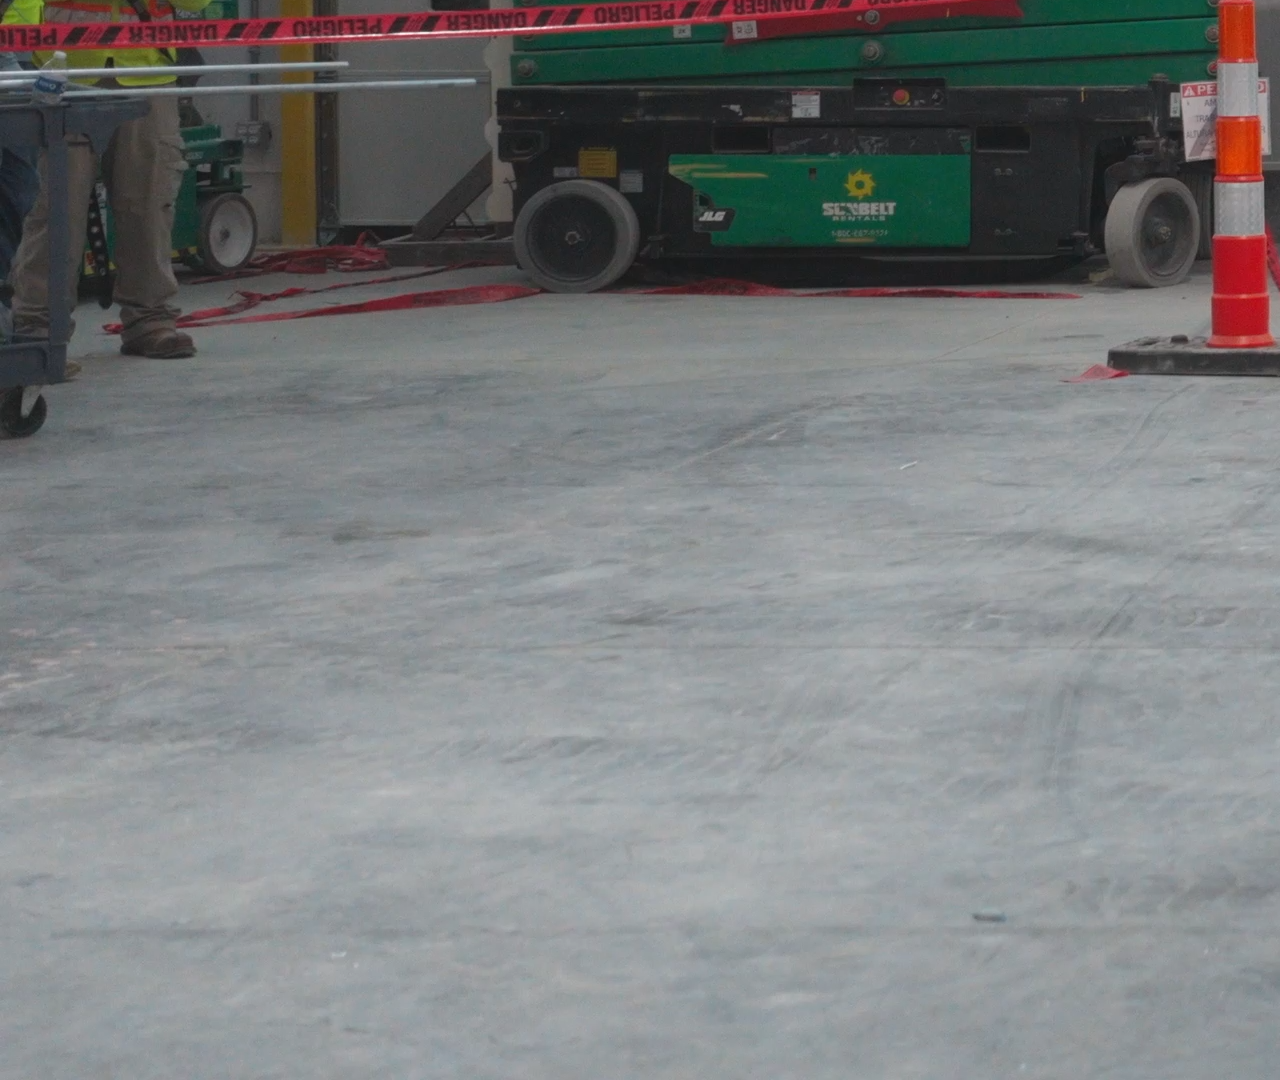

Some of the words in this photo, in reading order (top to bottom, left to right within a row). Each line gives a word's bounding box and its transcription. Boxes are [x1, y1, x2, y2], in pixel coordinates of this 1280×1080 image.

[448, 12, 527, 31] DANGER
[594, 2, 675, 23] PELIGRO
[129, 24, 218, 43] DANGER
[292, 19, 382, 36] PELIGRO
[698, 211, 727, 222] JLG
